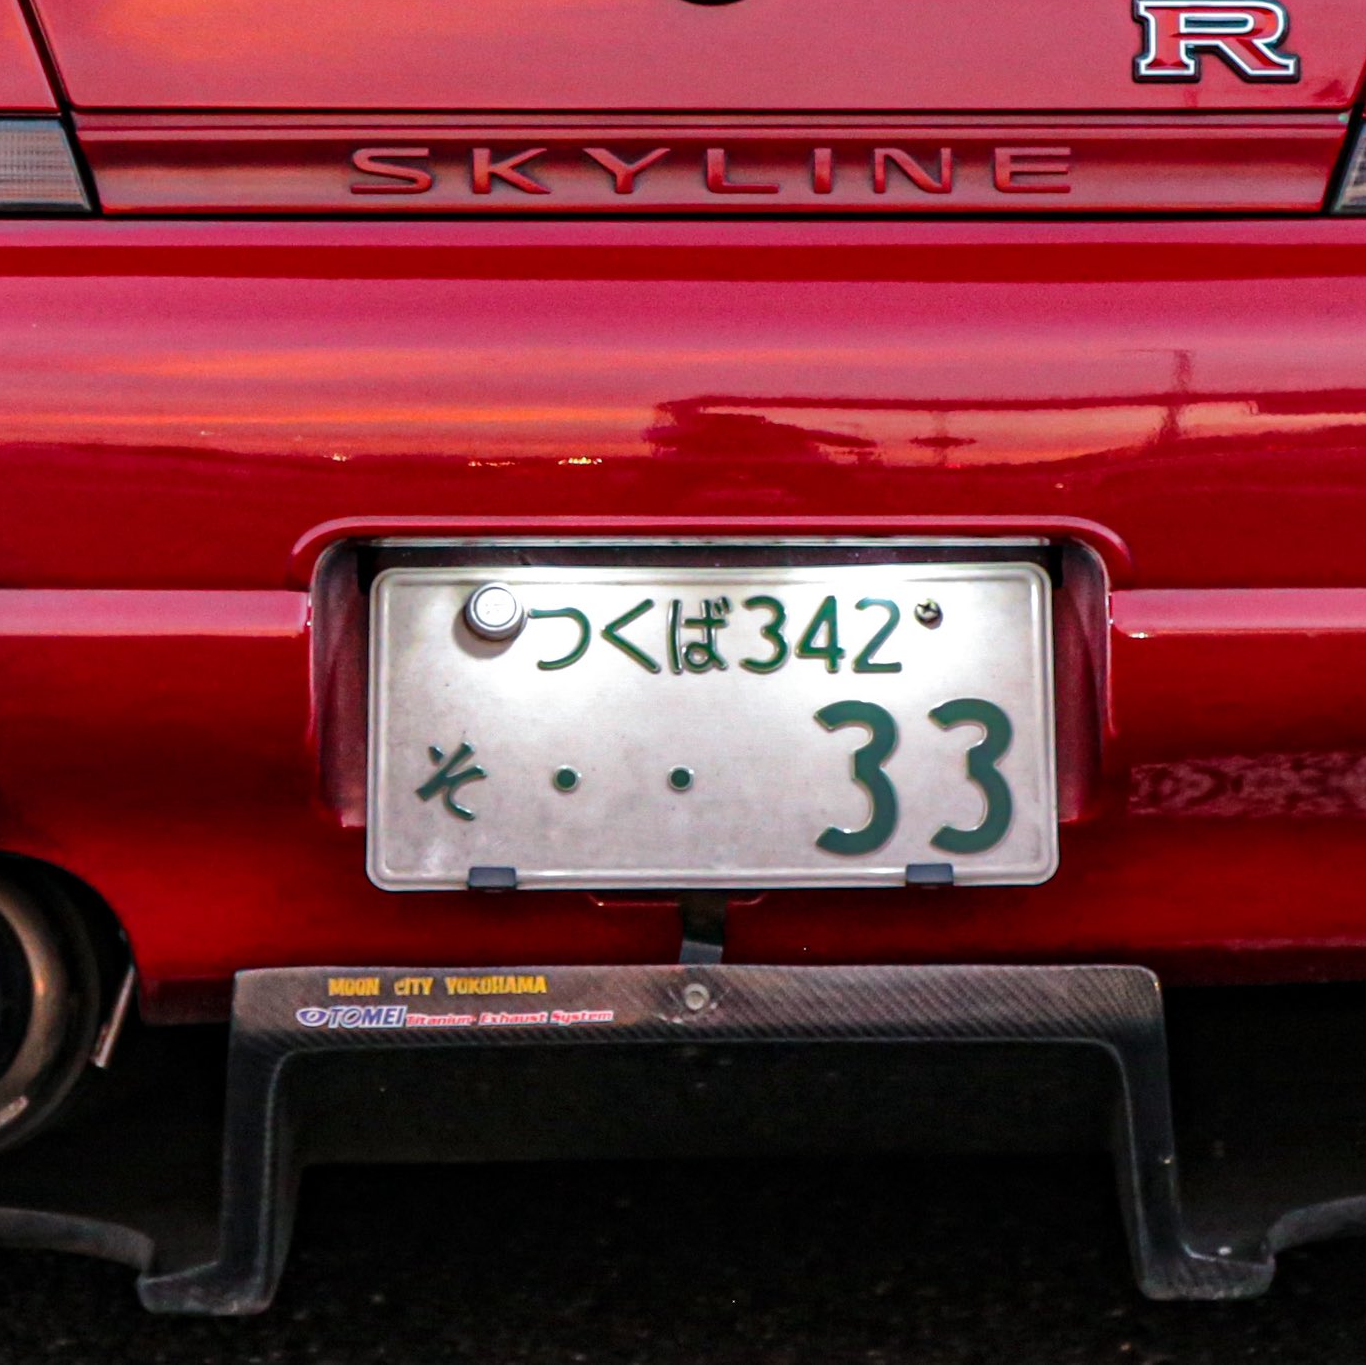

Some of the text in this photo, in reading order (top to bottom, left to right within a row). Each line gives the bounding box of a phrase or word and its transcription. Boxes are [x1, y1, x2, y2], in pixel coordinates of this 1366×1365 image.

[349, 146, 1073, 195] SKYLINE
[327, 976, 381, 997] MOON
[445, 975, 548, 996] YOKOHAMA
[327, 1005, 407, 1029] TOMEI
[478, 1009, 539, 1026] Exhaust
[549, 1008, 614, 1025] System
